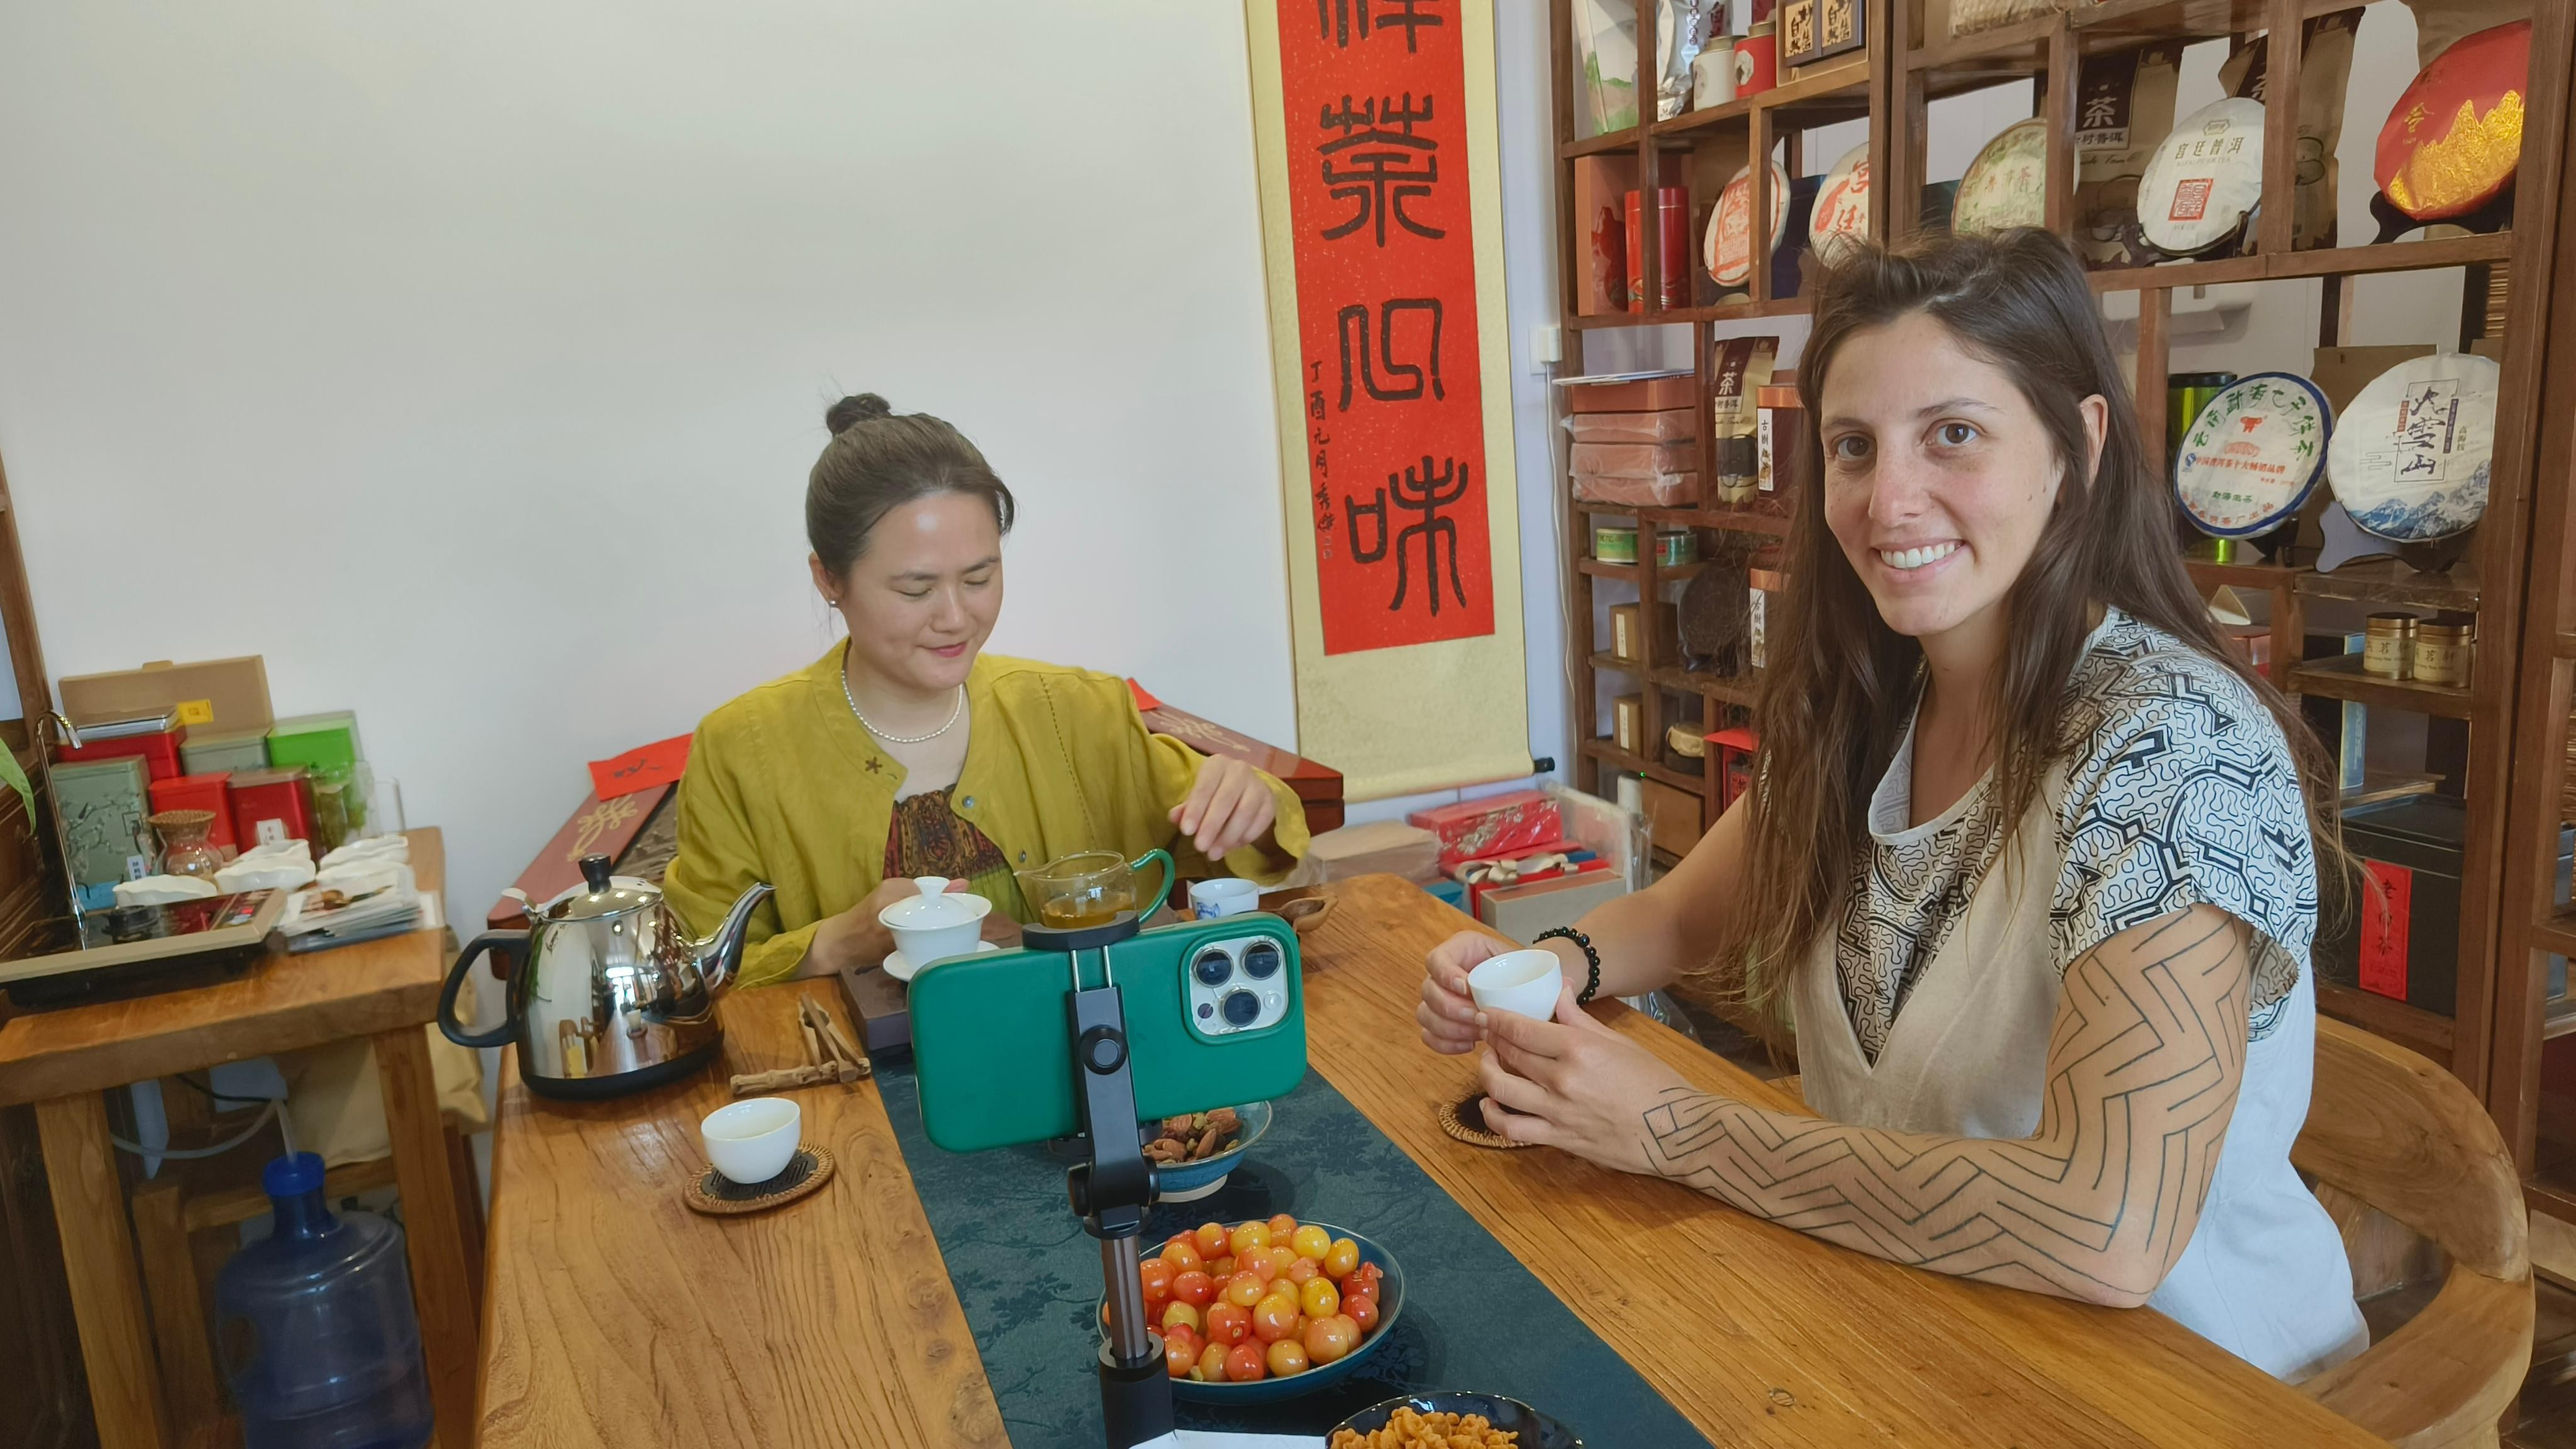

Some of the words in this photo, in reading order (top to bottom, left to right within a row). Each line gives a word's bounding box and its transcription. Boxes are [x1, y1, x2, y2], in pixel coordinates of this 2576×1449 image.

[2082, 96, 2118, 127] 茶
[2076, 131, 2123, 145] 树普洱
[1718, 372, 1738, 395] 茶
[2394, 386, 2448, 475] 大雪山
